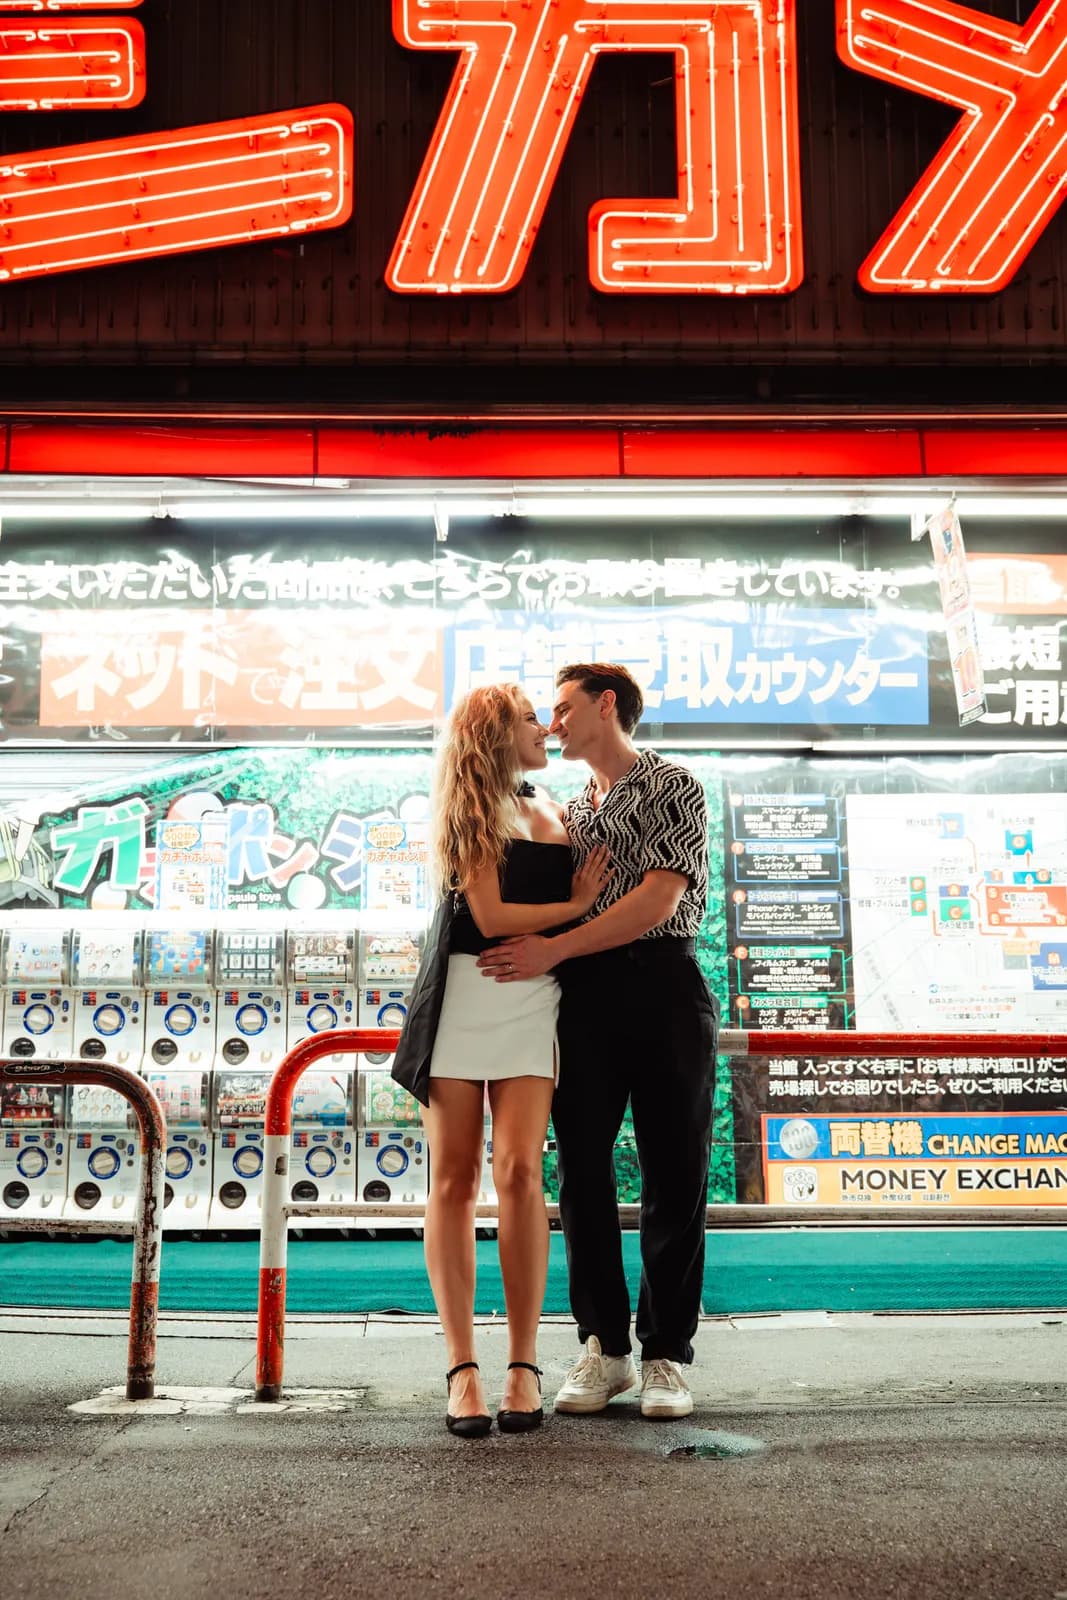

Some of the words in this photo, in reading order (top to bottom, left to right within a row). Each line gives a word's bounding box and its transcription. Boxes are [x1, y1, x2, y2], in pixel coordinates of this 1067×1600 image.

[259, 893, 281, 904] toys
[800, 904, 831, 912] ストラップ
[746, 912, 801, 920] モバイルバッテリー
[754, 959, 797, 967] フィルムカメラ
[803, 959, 828, 967] フィルム
[758, 1017, 777, 1025] レンズ
[769, 1060, 798, 1076] 当館
[829, 1121, 924, 1157] 両替機
[927, 1134, 1020, 1155] CHANGE
[841, 1170, 947, 1191] MONEY
